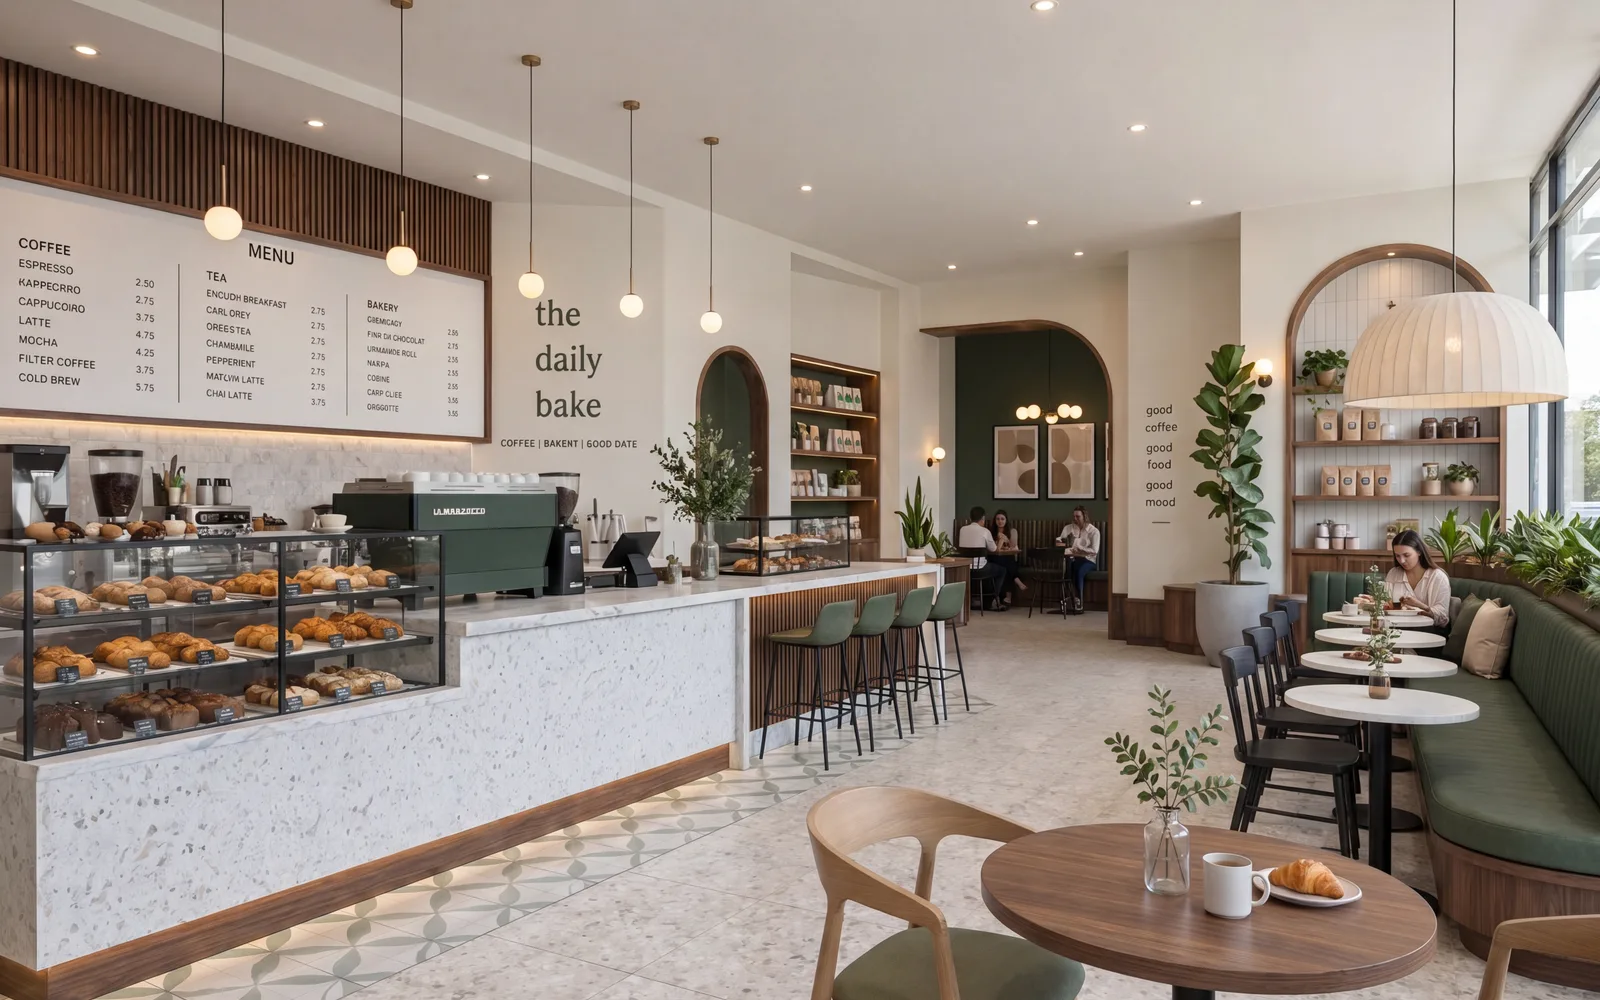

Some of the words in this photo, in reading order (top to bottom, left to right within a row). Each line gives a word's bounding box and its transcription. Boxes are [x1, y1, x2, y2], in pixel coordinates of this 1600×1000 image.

[18, 238, 71, 256] COFFEE
[249, 243, 294, 265] MENU
[18, 259, 74, 275] ESPRESSO
[135, 278, 155, 288] 2.50
[206, 270, 227, 283] TEA
[135, 296, 155, 305] 2.75
[243, 295, 287, 309] BREAKFAST
[311, 307, 326, 316] 2.75
[367, 299, 399, 312] BAKERY
[135, 313, 155, 322] 3.75
[206, 306, 228, 316] CARL
[229, 309, 251, 319] OREY
[535, 299, 581, 326] the
[18, 316, 51, 328] LATTE
[135, 331, 155, 340] 4.75
[18, 335, 58, 347] MOCHA
[135, 348, 155, 357] 4.25
[393, 335, 425, 344] CHOCOLAT
[311, 352, 326, 361] 2.75
[402, 349, 417, 358] ROLL
[18, 354, 54, 365] FILTER
[57, 358, 96, 369] COFFEE
[135, 366, 155, 375] 3.75
[535, 344, 602, 378] daily
[311, 368, 326, 376] 2.75
[18, 373, 47, 383] COLD
[51, 376, 81, 386] BREW
[135, 383, 155, 392] 5.75
[242, 375, 265, 385] LATTE
[311, 383, 326, 391] 2.75
[206, 389, 226, 398] CHAI
[228, 391, 252, 400] LATTE
[311, 399, 326, 407] 3.75
[535, 390, 601, 418] bake
[1146, 404, 1173, 417] good
[1145, 422, 1178, 432] coffee
[501, 439, 535, 448] COFFEE
[544, 439, 578, 448] BAKENT
[615, 440, 637, 448] DATE
[1146, 442, 1173, 455] good
[1147, 459, 1172, 469] food
[1146, 480, 1173, 492] good
[1146, 497, 1176, 507] mood
